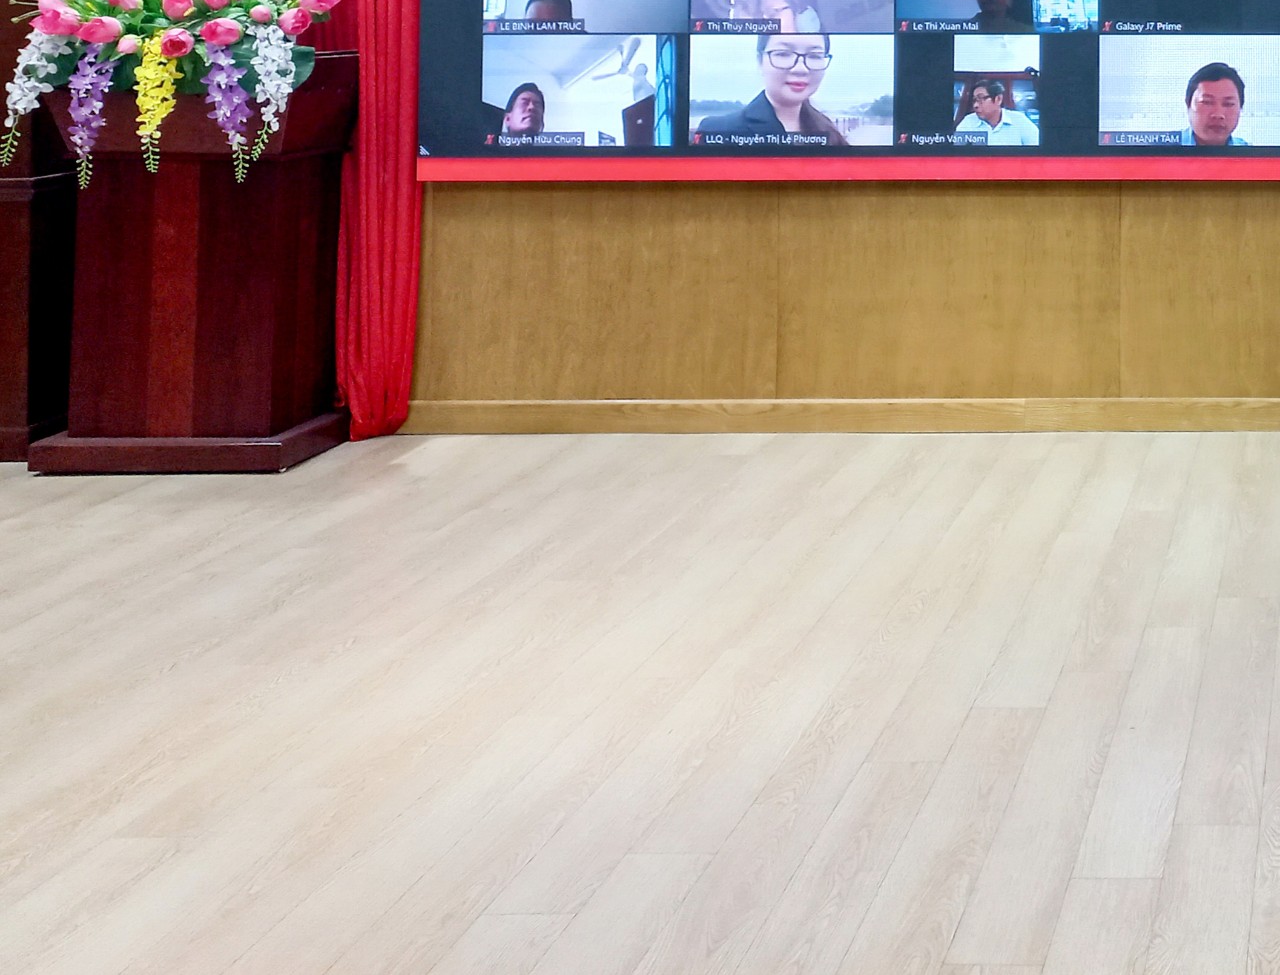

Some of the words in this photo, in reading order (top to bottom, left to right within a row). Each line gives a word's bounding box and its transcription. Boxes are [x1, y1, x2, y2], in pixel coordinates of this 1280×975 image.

[912, 22, 924, 31] Le
[939, 22, 962, 31] Xuan
[1115, 22, 1145, 33] Galaxy
[1145, 23, 1156, 31] J7
[1156, 22, 1182, 31] Prime
[553, 135, 582, 146] Chung
[731, 134, 765, 146] Nguyễn
[793, 135, 827, 146] Phương
[964, 135, 986, 144] Nam
[1127, 135, 1159, 143] THANH
